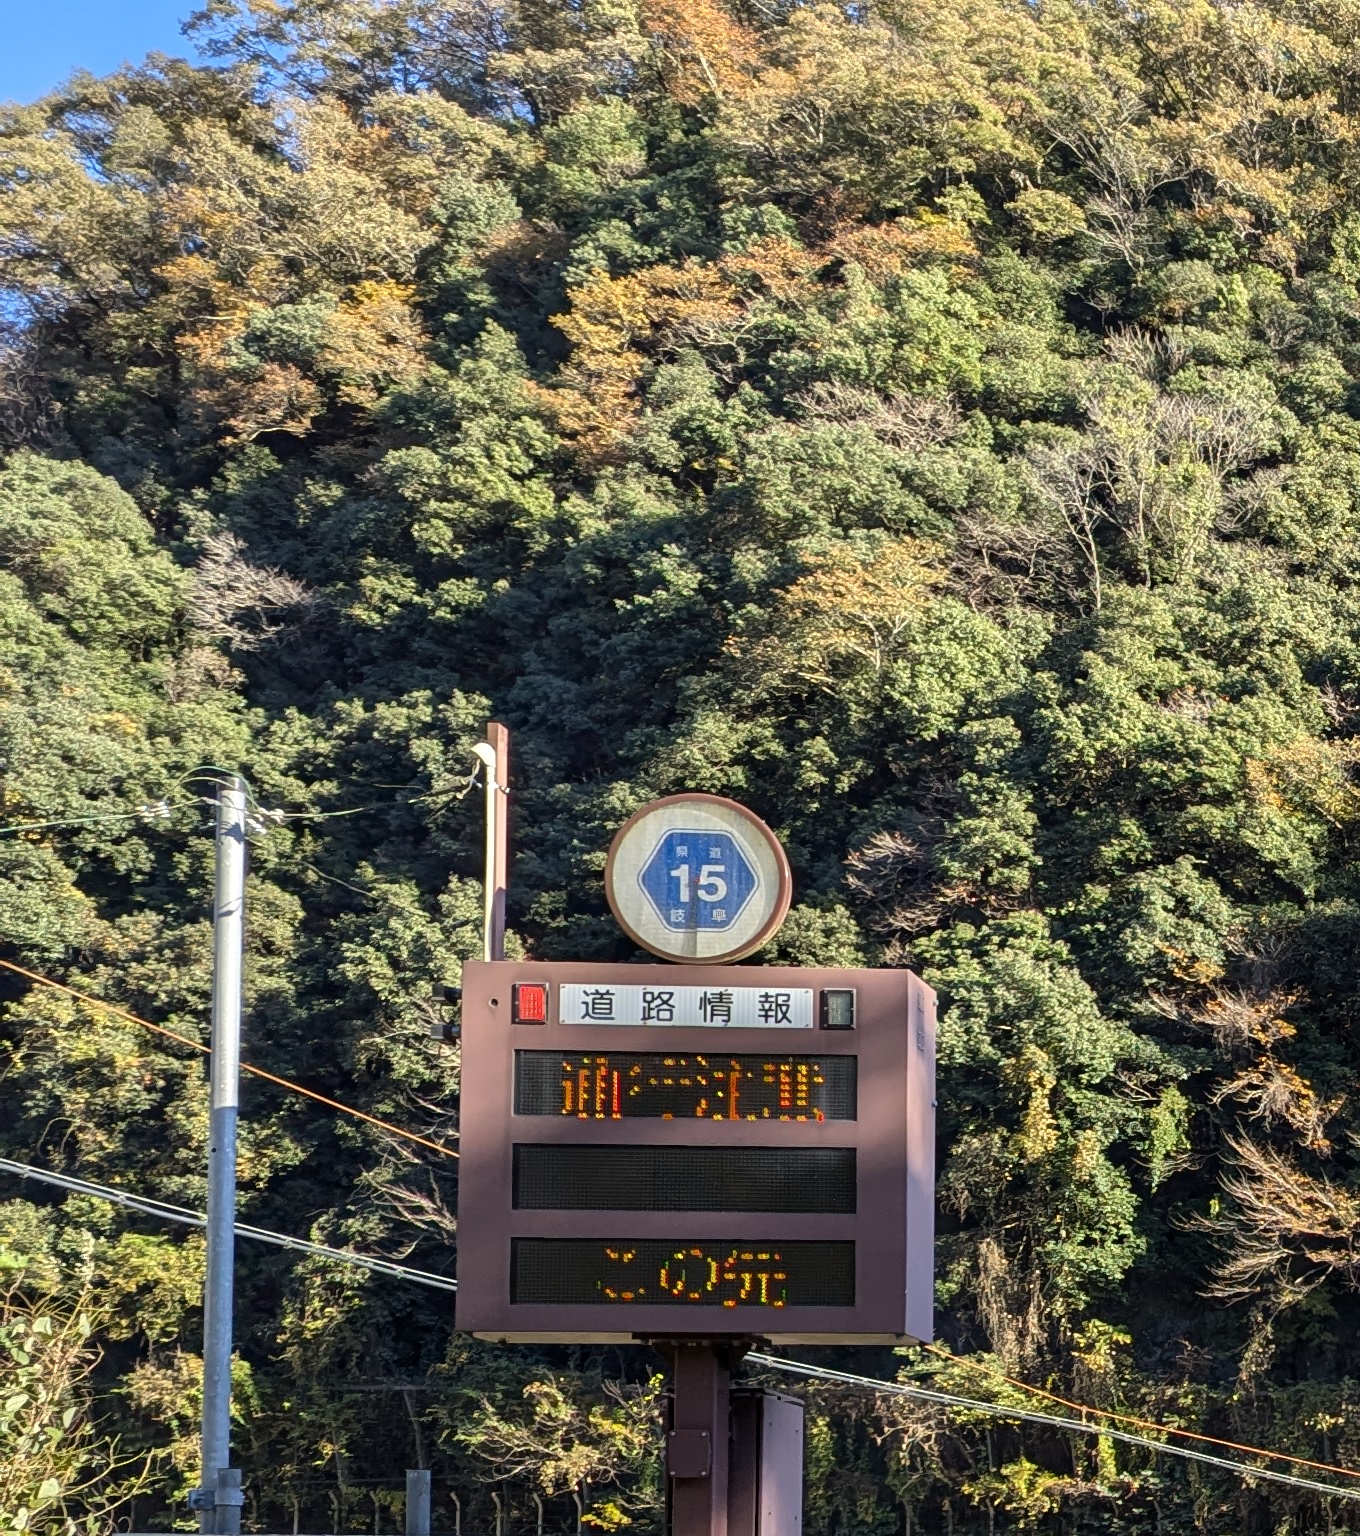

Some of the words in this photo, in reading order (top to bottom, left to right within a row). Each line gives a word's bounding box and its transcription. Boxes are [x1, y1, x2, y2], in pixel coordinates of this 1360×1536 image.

[675, 845, 722, 859] 県道
[670, 864, 728, 903] 15
[669, 908, 727, 923] 岐阜
[580, 989, 793, 1025] 道路情報
